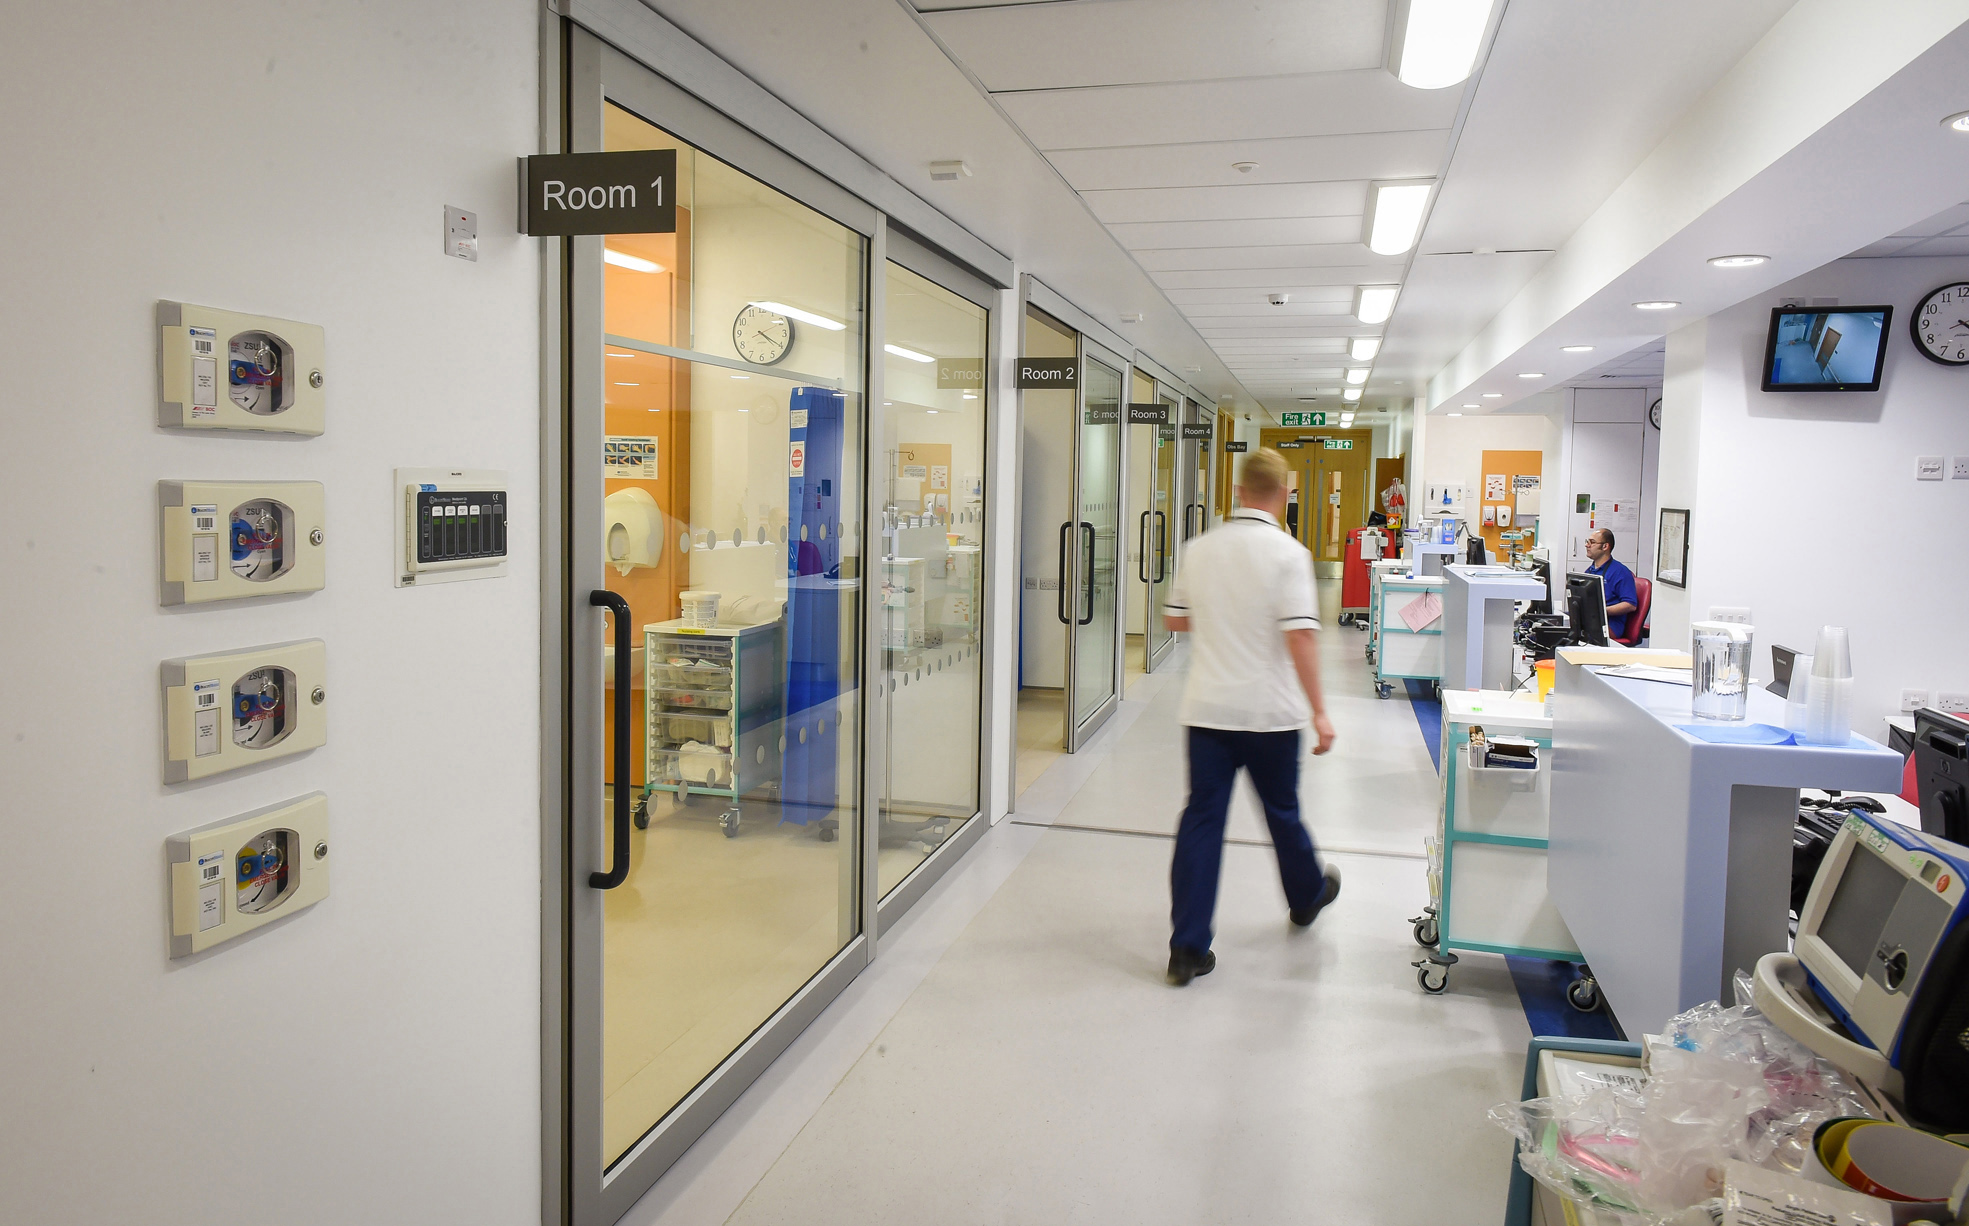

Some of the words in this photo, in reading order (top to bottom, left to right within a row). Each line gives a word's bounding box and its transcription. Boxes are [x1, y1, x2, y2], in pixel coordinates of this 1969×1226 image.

[543, 180, 636, 211] Room
[650, 175, 662, 207] 1
[1957, 286, 1969, 298] 12
[1941, 292, 1951, 303] 11
[748, 309, 755, 318] 11
[1925, 303, 1938, 315] 10
[739, 317, 747, 326] 10
[1921, 319, 1930, 330] 9
[737, 329, 742, 338] 9
[782, 330, 787, 338] 3
[1926, 333, 1935, 344] 8
[740, 340, 745, 349] 8
[749, 351, 754, 359] 7
[770, 350, 775, 359] 5
[1940, 345, 1949, 356] 7
[1957, 348, 1965, 359] 6
[759, 353, 764, 361] 6
[1022, 367, 1062, 380] Room
[1066, 367, 1074, 380] 2
[1131, 409, 1158, 419] Room
[1160, 410, 1166, 419] 3
